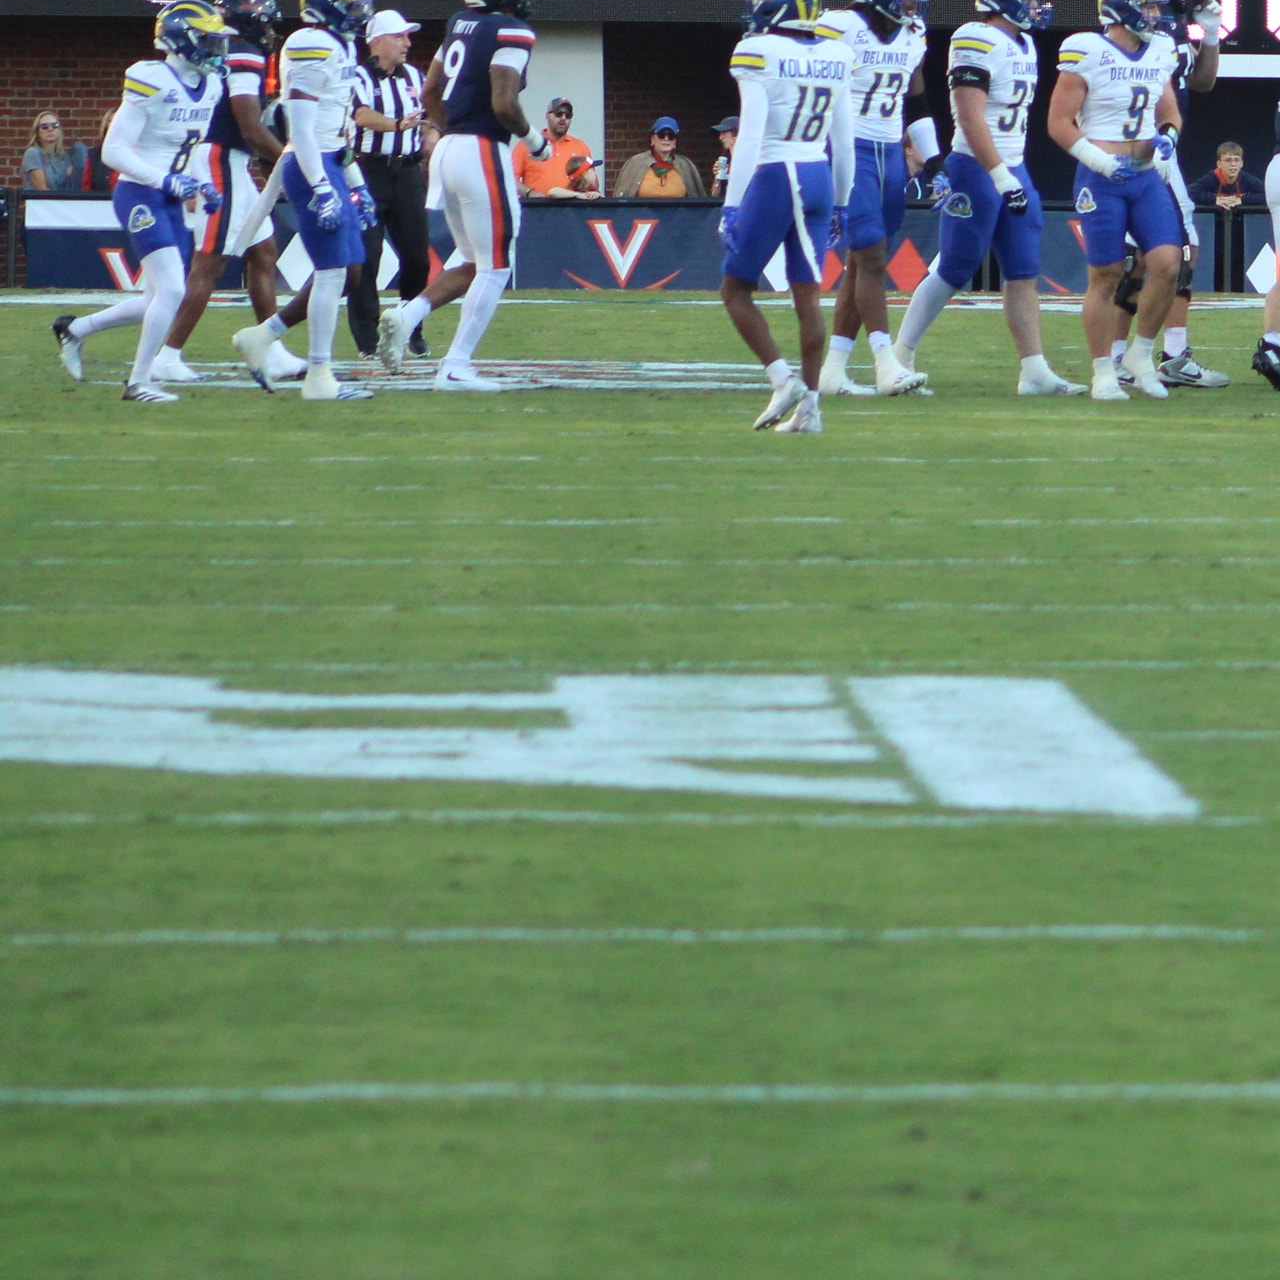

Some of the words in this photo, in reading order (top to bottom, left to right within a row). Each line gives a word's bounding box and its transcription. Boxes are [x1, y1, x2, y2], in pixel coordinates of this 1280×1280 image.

[442, 41, 465, 101] 9
[863, 50, 908, 67] DELAWARE
[1111, 67, 1160, 82] DELAWARE
[785, 86, 832, 142] 18
[860, 72, 904, 118] 13
[1123, 86, 1149, 139] 9
[171, 130, 201, 175] 8
